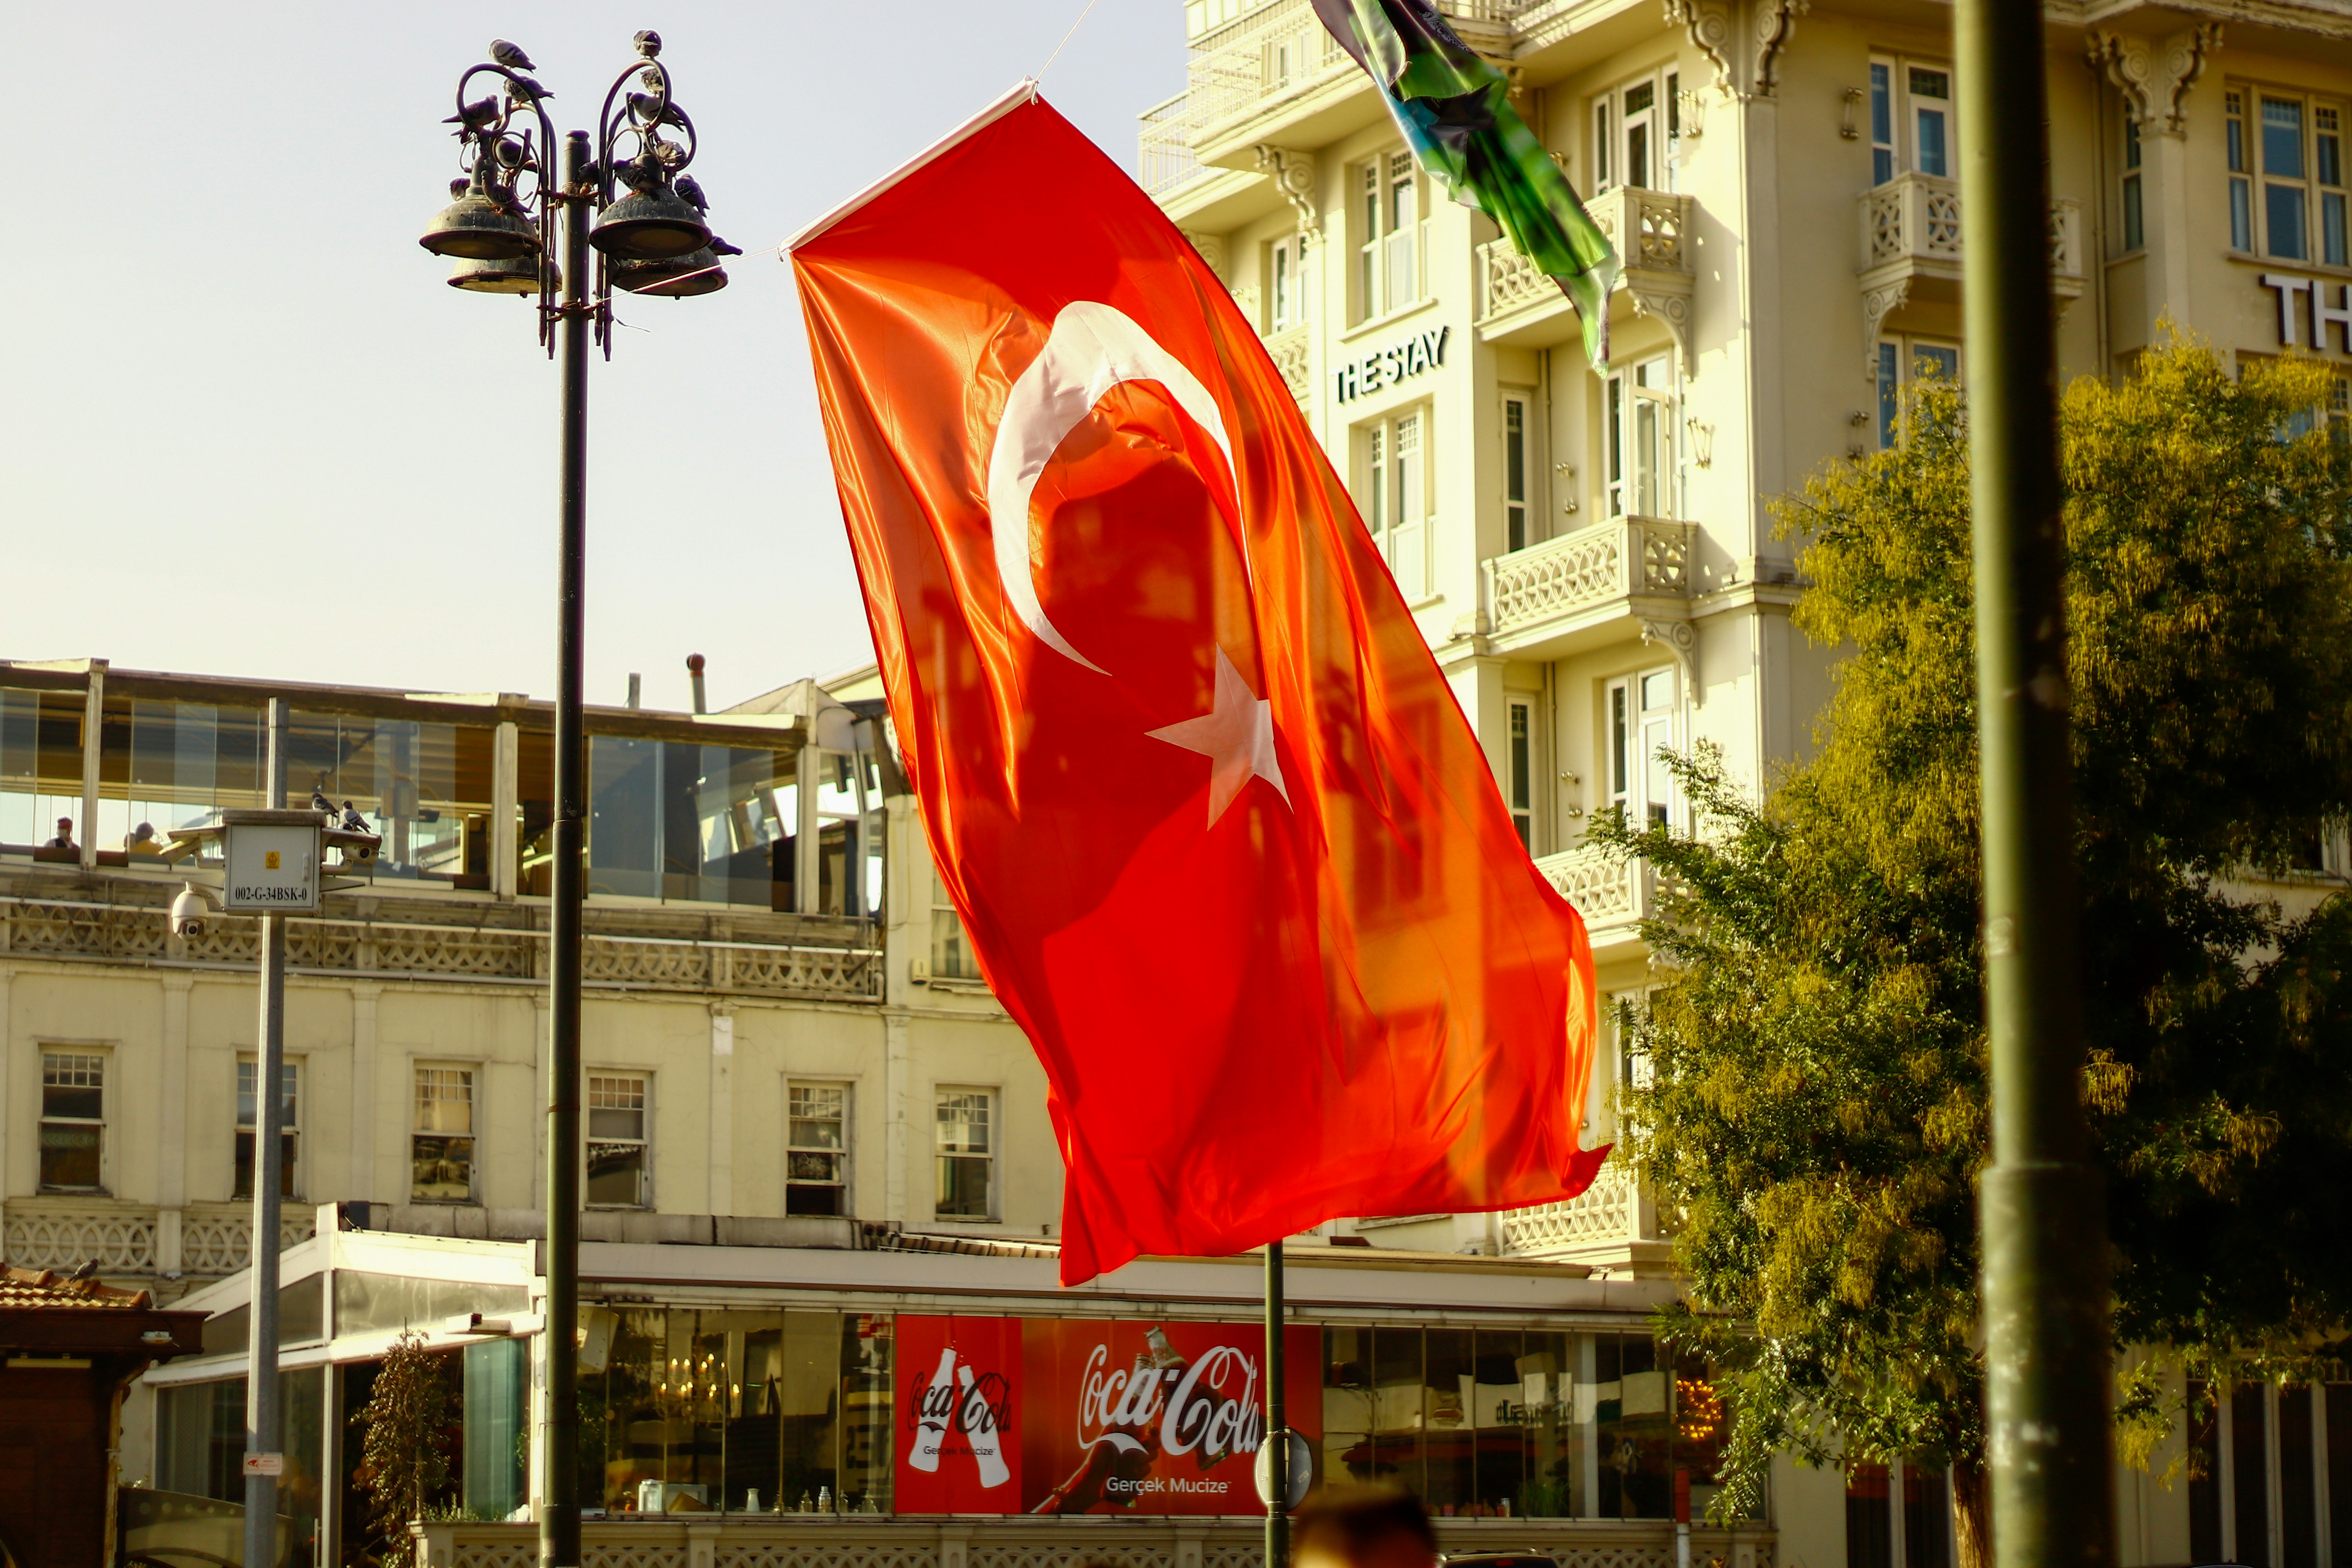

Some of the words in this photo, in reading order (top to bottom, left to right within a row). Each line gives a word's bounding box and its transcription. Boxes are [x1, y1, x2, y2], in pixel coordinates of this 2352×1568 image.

[1330, 353, 1381, 403] THE
[1381, 325, 1450, 384] STAY
[235, 887, 307, 901] 002-G-34BSK-0
[1077, 1344, 1260, 1455] Coca-Cola
[924, 1446, 957, 1456] Gerçek
[1105, 1477, 1166, 1496] Gerçek
